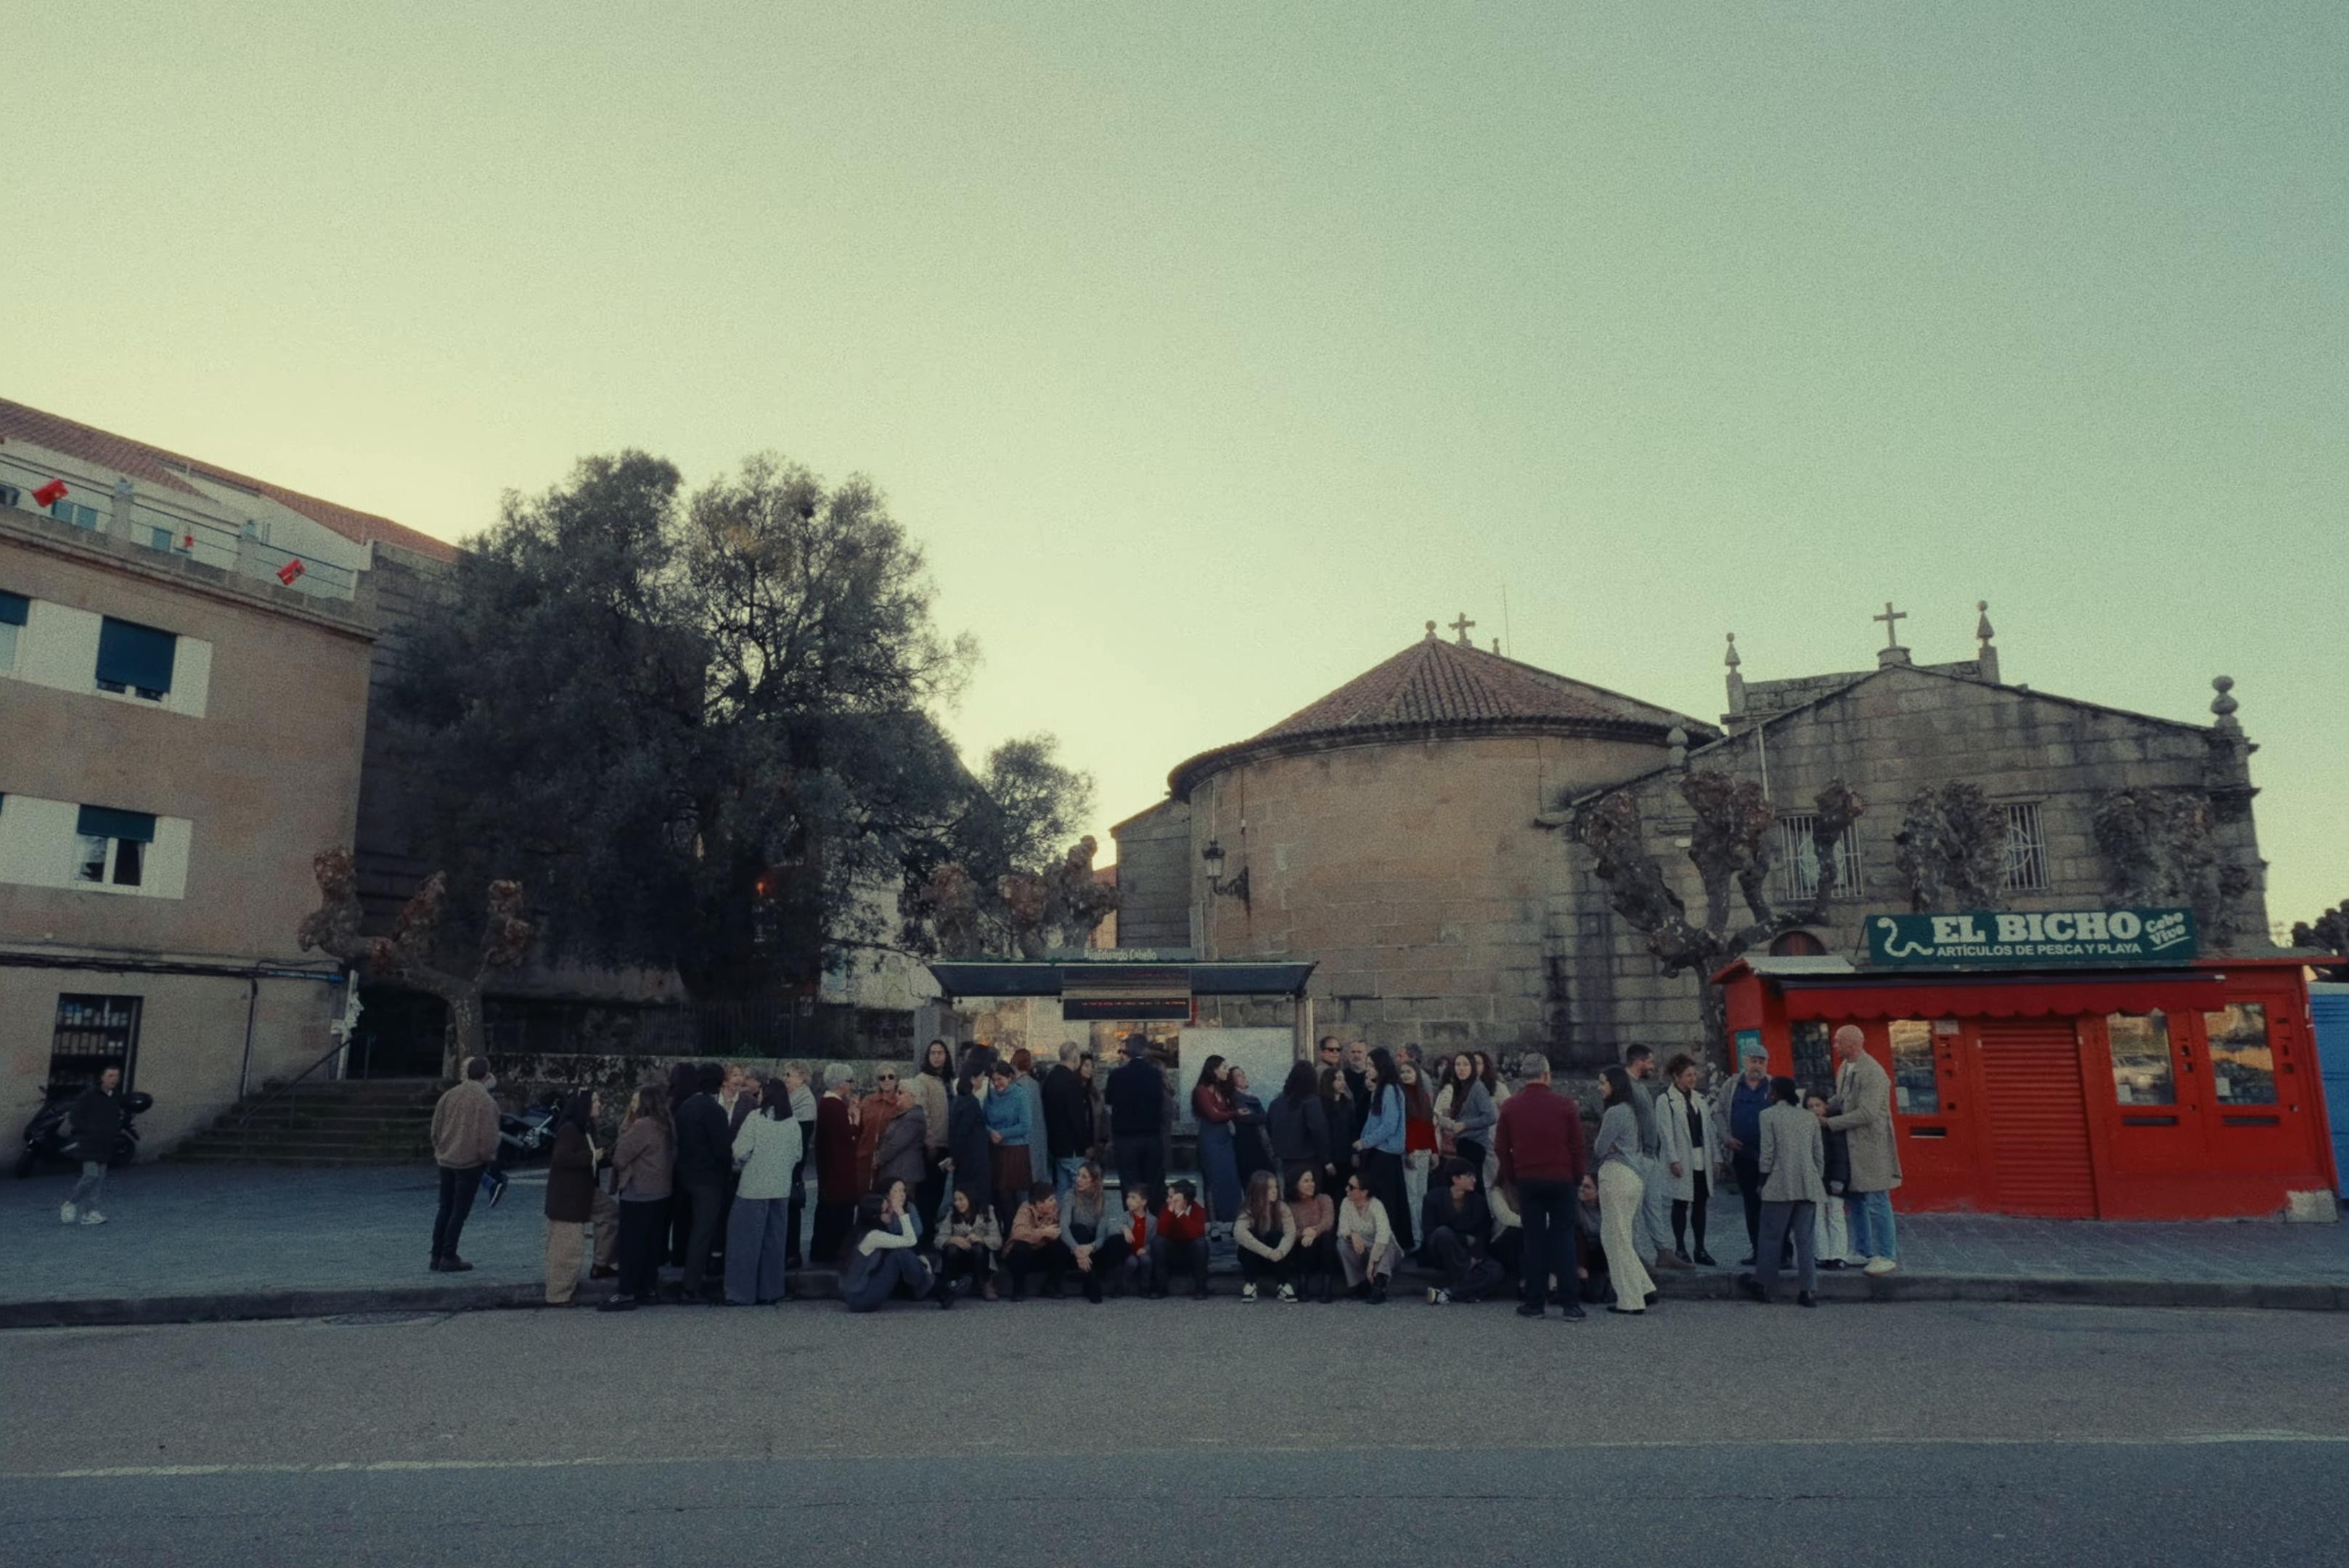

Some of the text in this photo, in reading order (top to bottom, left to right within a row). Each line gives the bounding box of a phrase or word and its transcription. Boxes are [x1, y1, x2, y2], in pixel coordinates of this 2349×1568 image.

[1931, 912, 2141, 943] EL BICHO
[1937, 943, 2142, 957] ARTÍCULOS DE PESCA Y PLAYA
